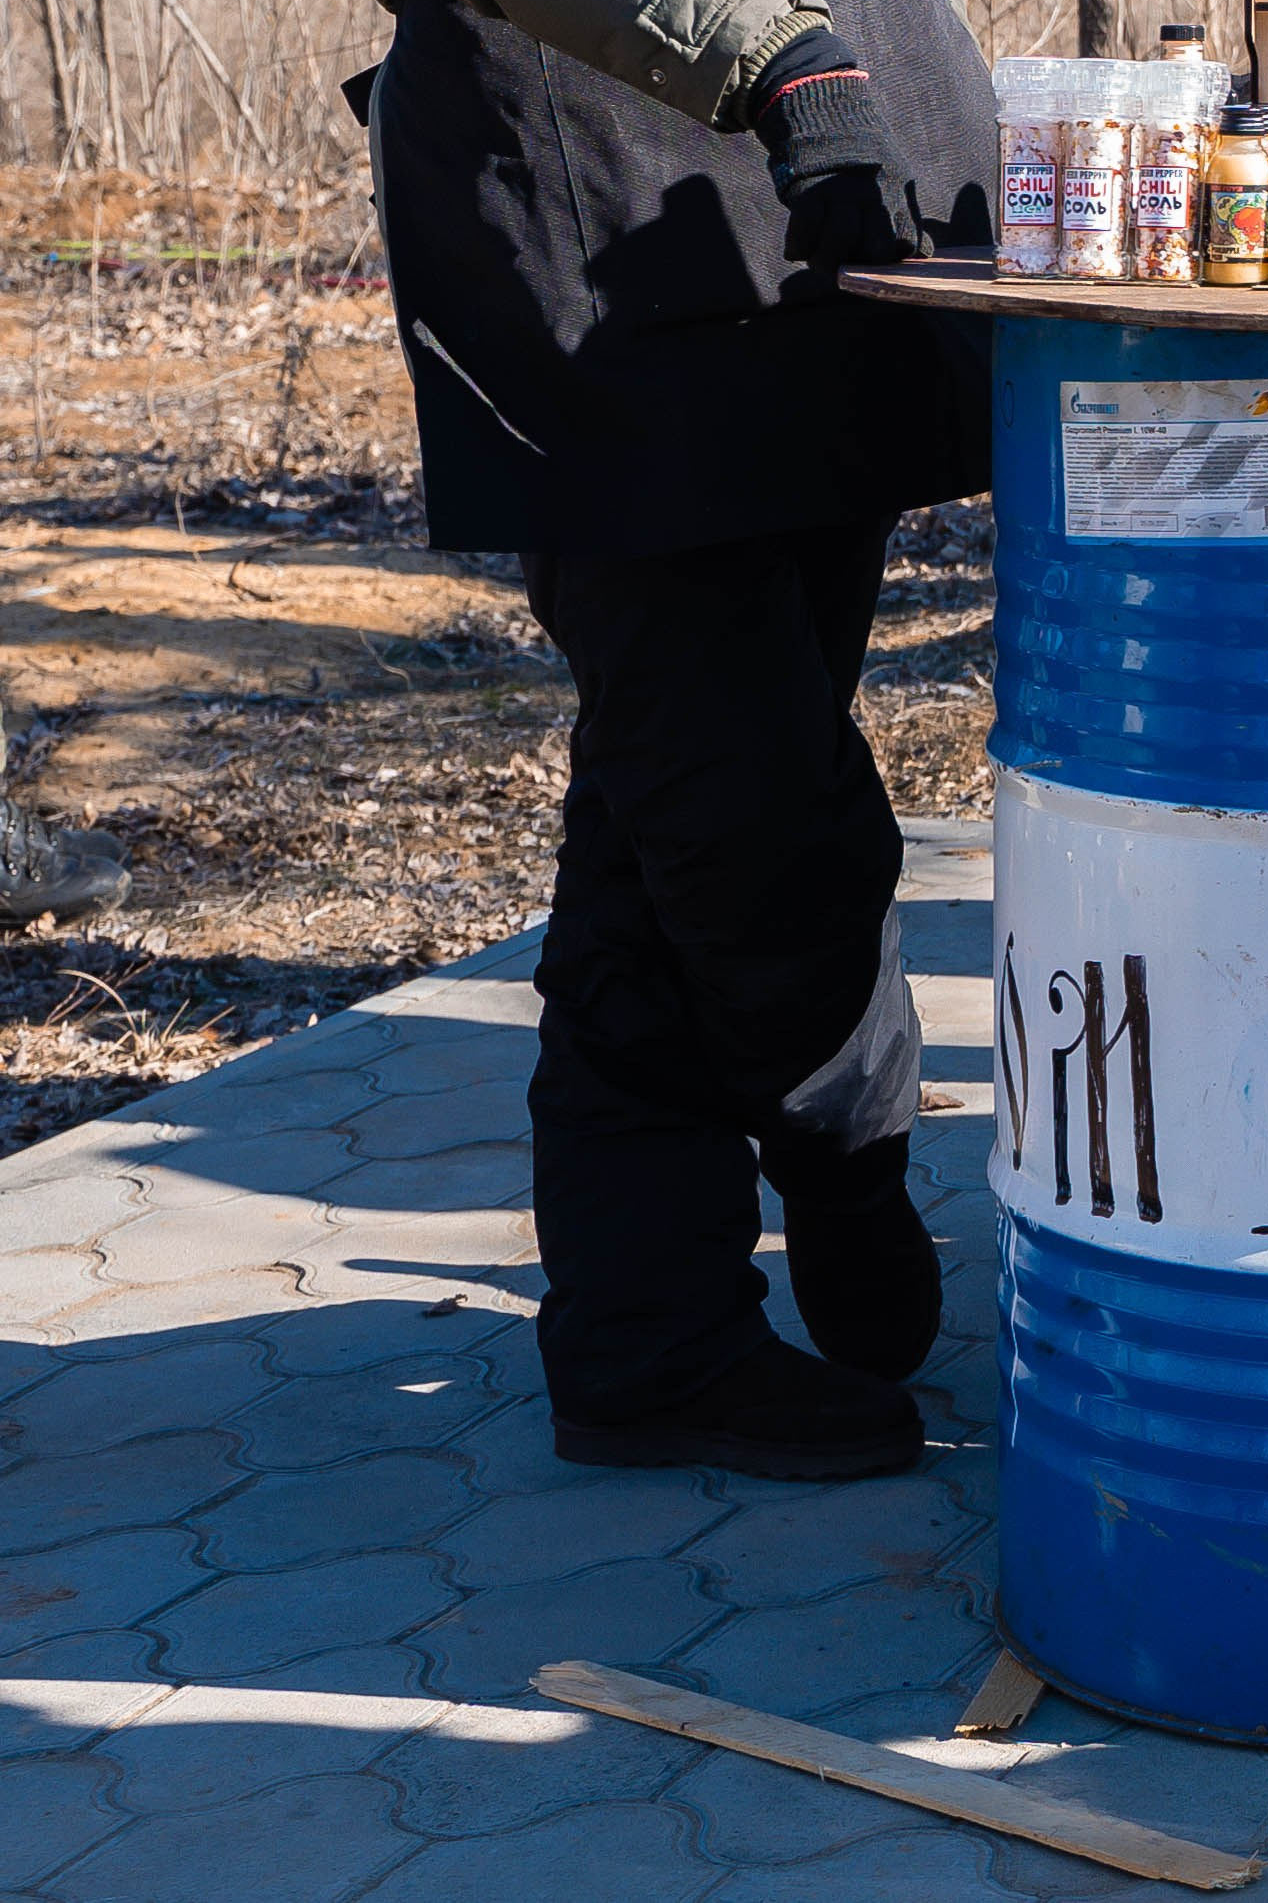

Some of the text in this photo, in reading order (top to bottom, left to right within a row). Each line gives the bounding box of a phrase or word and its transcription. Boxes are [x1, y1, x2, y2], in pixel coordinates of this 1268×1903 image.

[1007, 177, 1053, 191] CHILI
[1065, 182, 1107, 197] CHILI
[1140, 180, 1182, 194] CHILI
[1007, 193, 1053, 207] СОЛЬ
